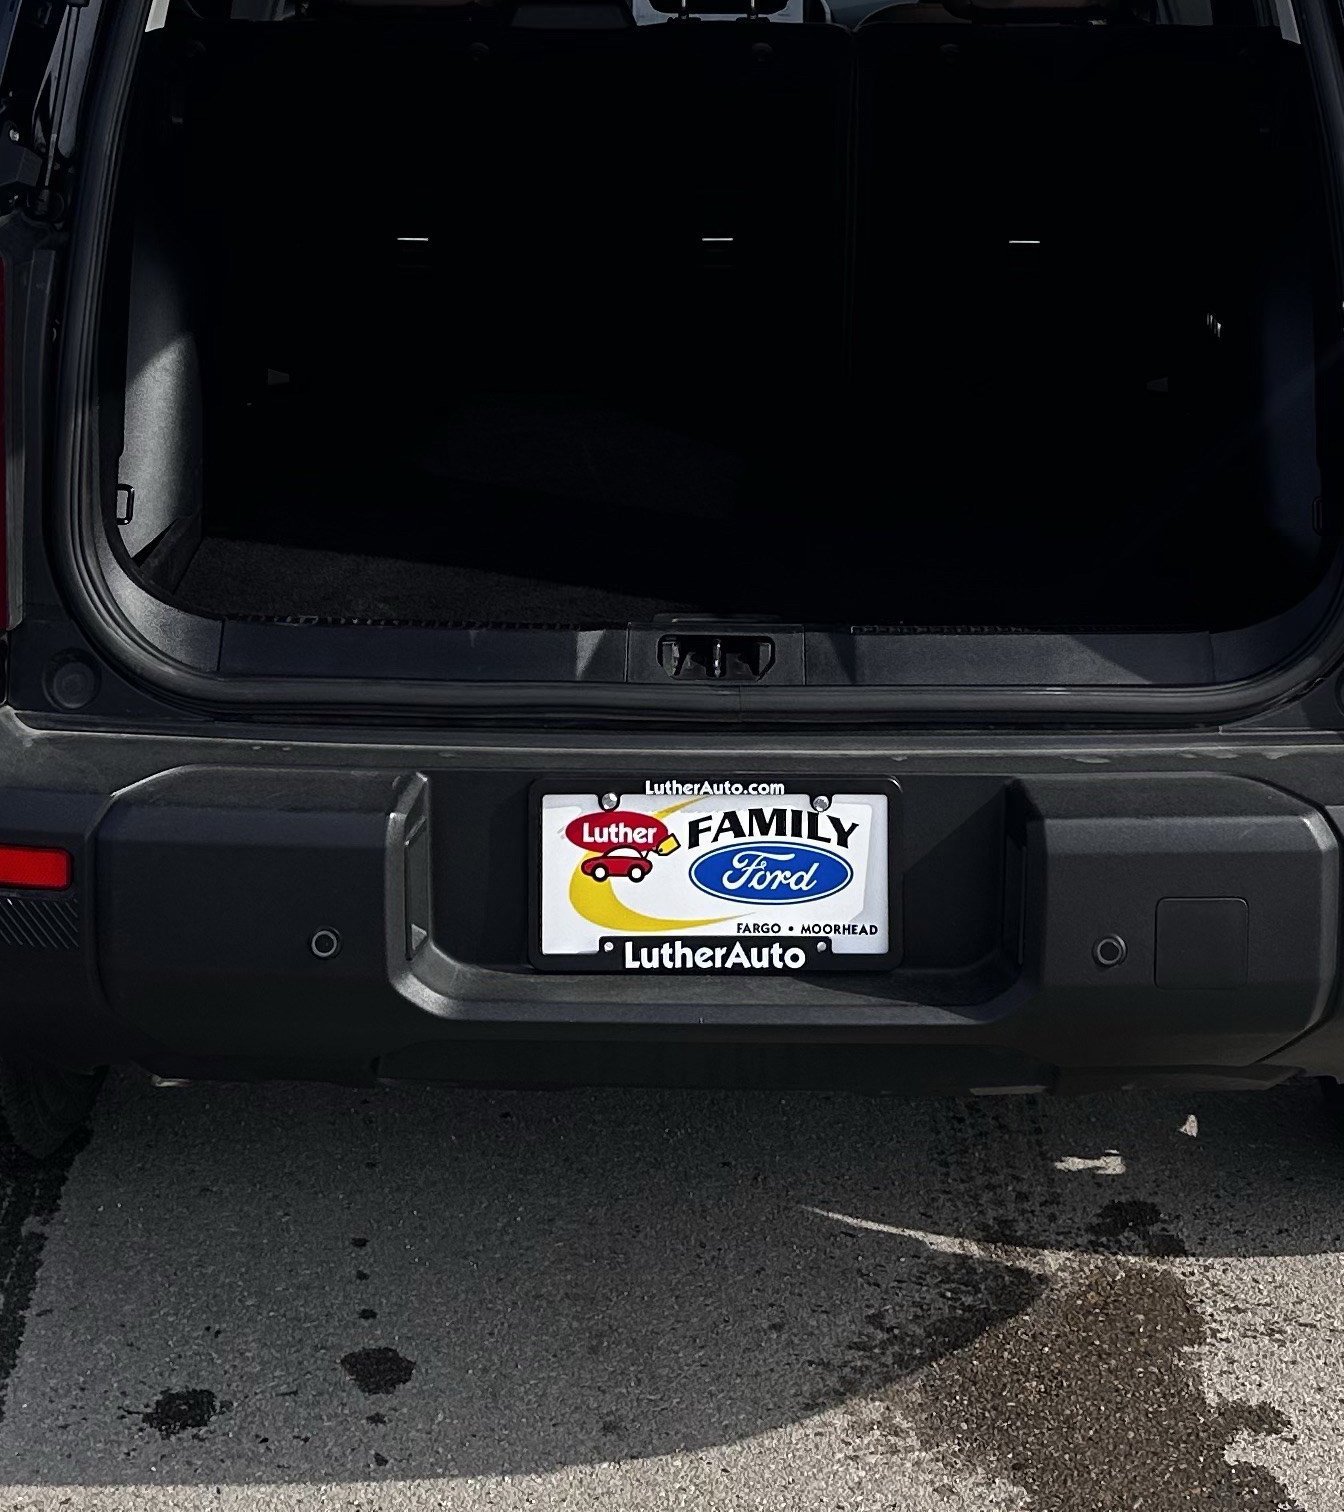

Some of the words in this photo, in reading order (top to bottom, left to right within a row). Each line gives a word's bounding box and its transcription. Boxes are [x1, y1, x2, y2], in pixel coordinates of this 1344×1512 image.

[645, 779, 785, 796] LutherAuto.com
[582, 822, 658, 845] Luther
[687, 807, 860, 850] FAMILY
[722, 850, 817, 891] Ford
[736, 922, 782, 935] FARGO
[800, 922, 879, 936] MOORHEAD
[624, 940, 807, 969] LutherAuto
